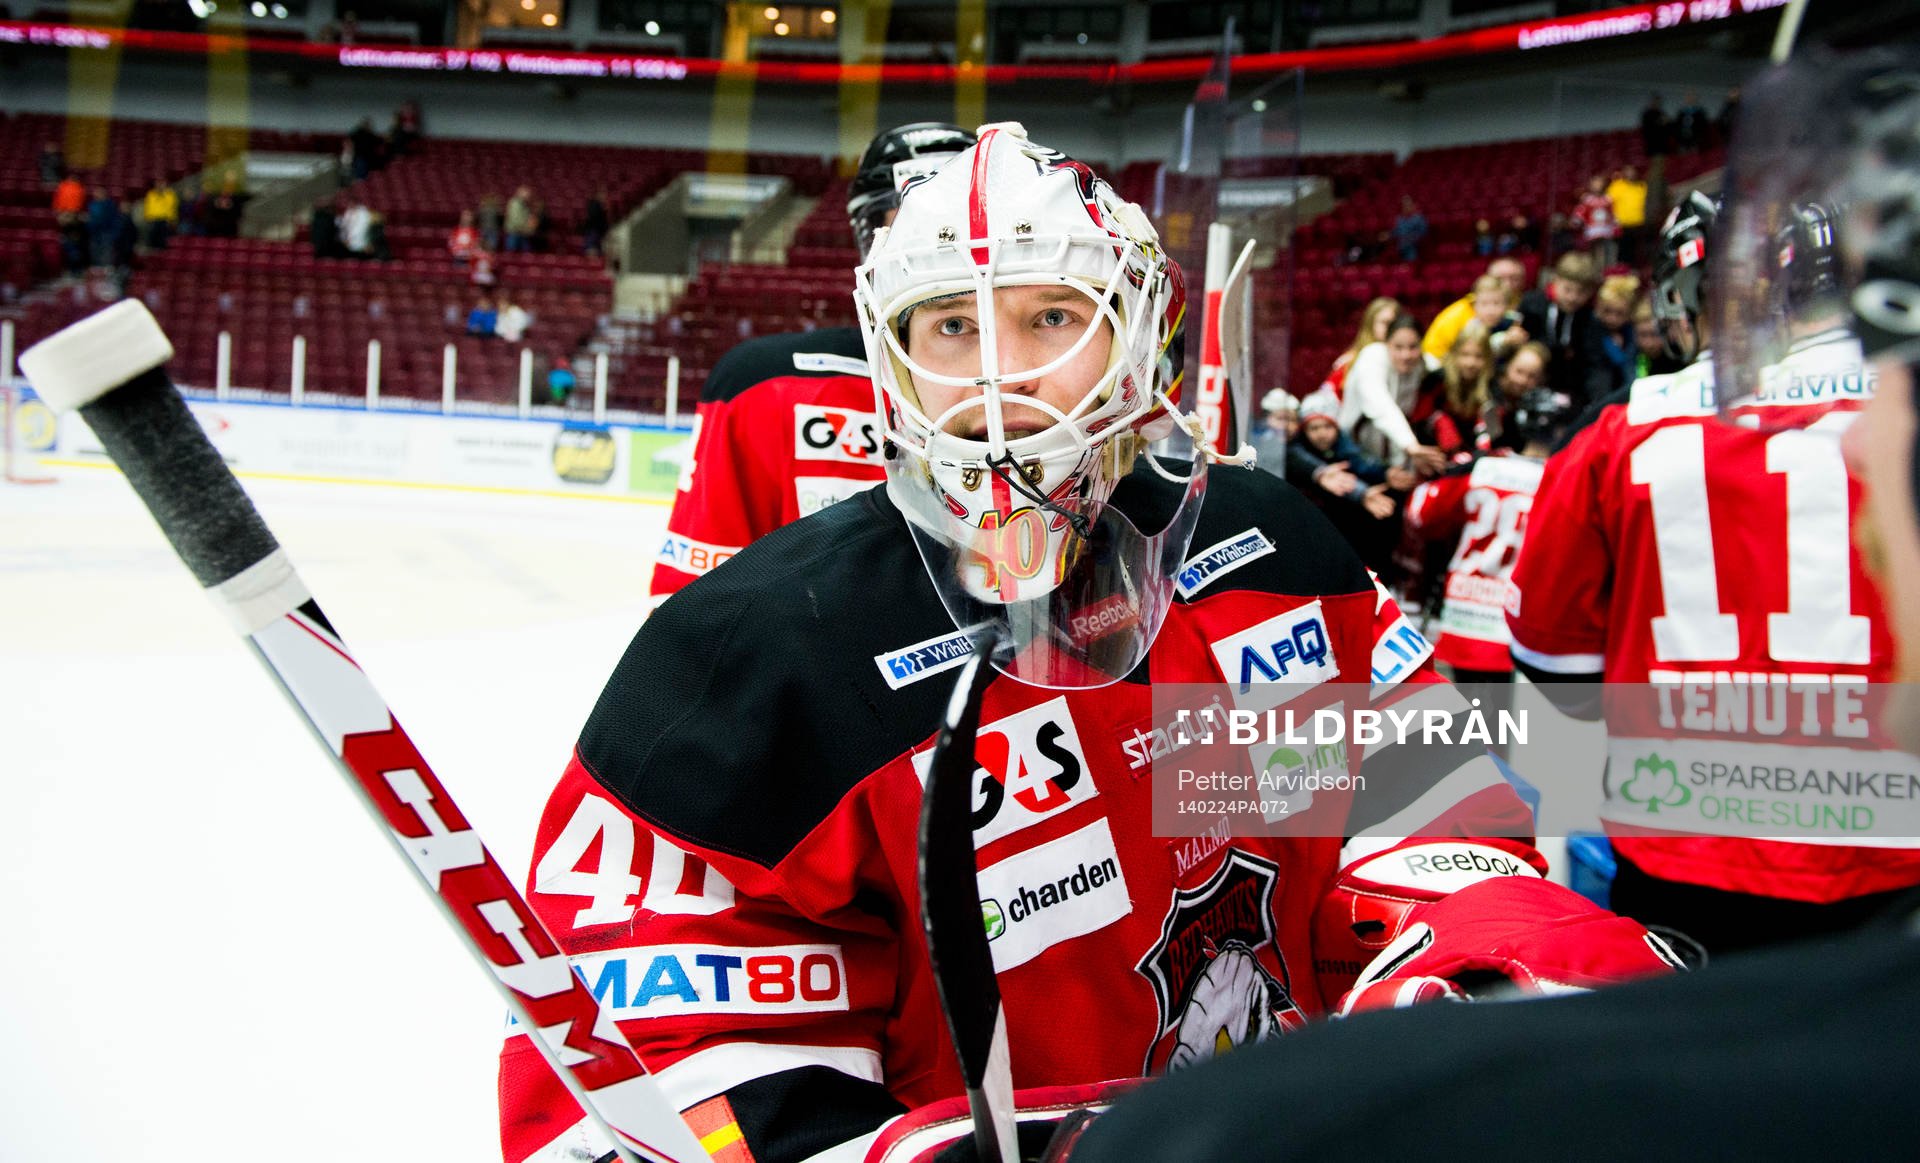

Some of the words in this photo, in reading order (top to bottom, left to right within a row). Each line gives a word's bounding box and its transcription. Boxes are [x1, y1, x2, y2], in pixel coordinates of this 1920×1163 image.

[802, 412, 878, 459] G4S
[1631, 412, 1871, 664] 11
[1648, 670, 1869, 739] TENUTE
[534, 792, 736, 929] 40
[1008, 857, 1118, 923] charden
[1404, 850, 1519, 876] Reebok
